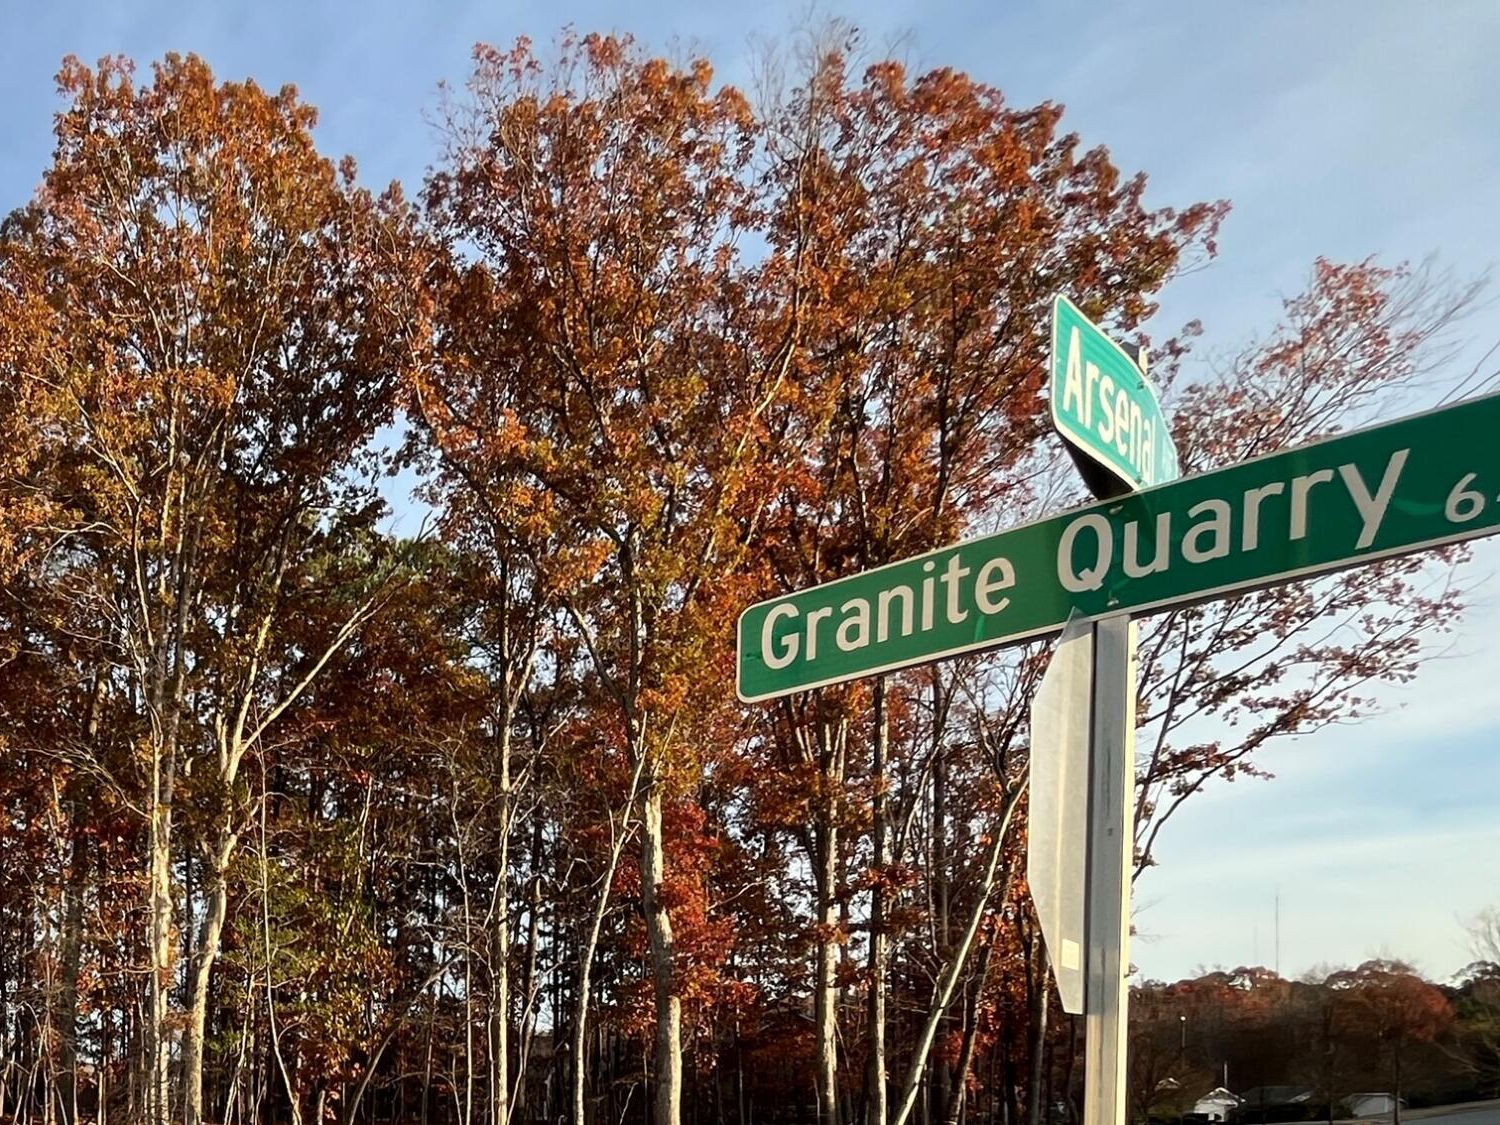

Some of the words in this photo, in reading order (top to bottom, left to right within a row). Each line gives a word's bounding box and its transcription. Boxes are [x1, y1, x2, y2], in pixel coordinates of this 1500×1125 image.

[1062, 325, 1157, 486] Arsenal
[760, 553, 1016, 670] Granite
[1056, 448, 1411, 593] Quarry
[1444, 472, 1500, 523] 6
